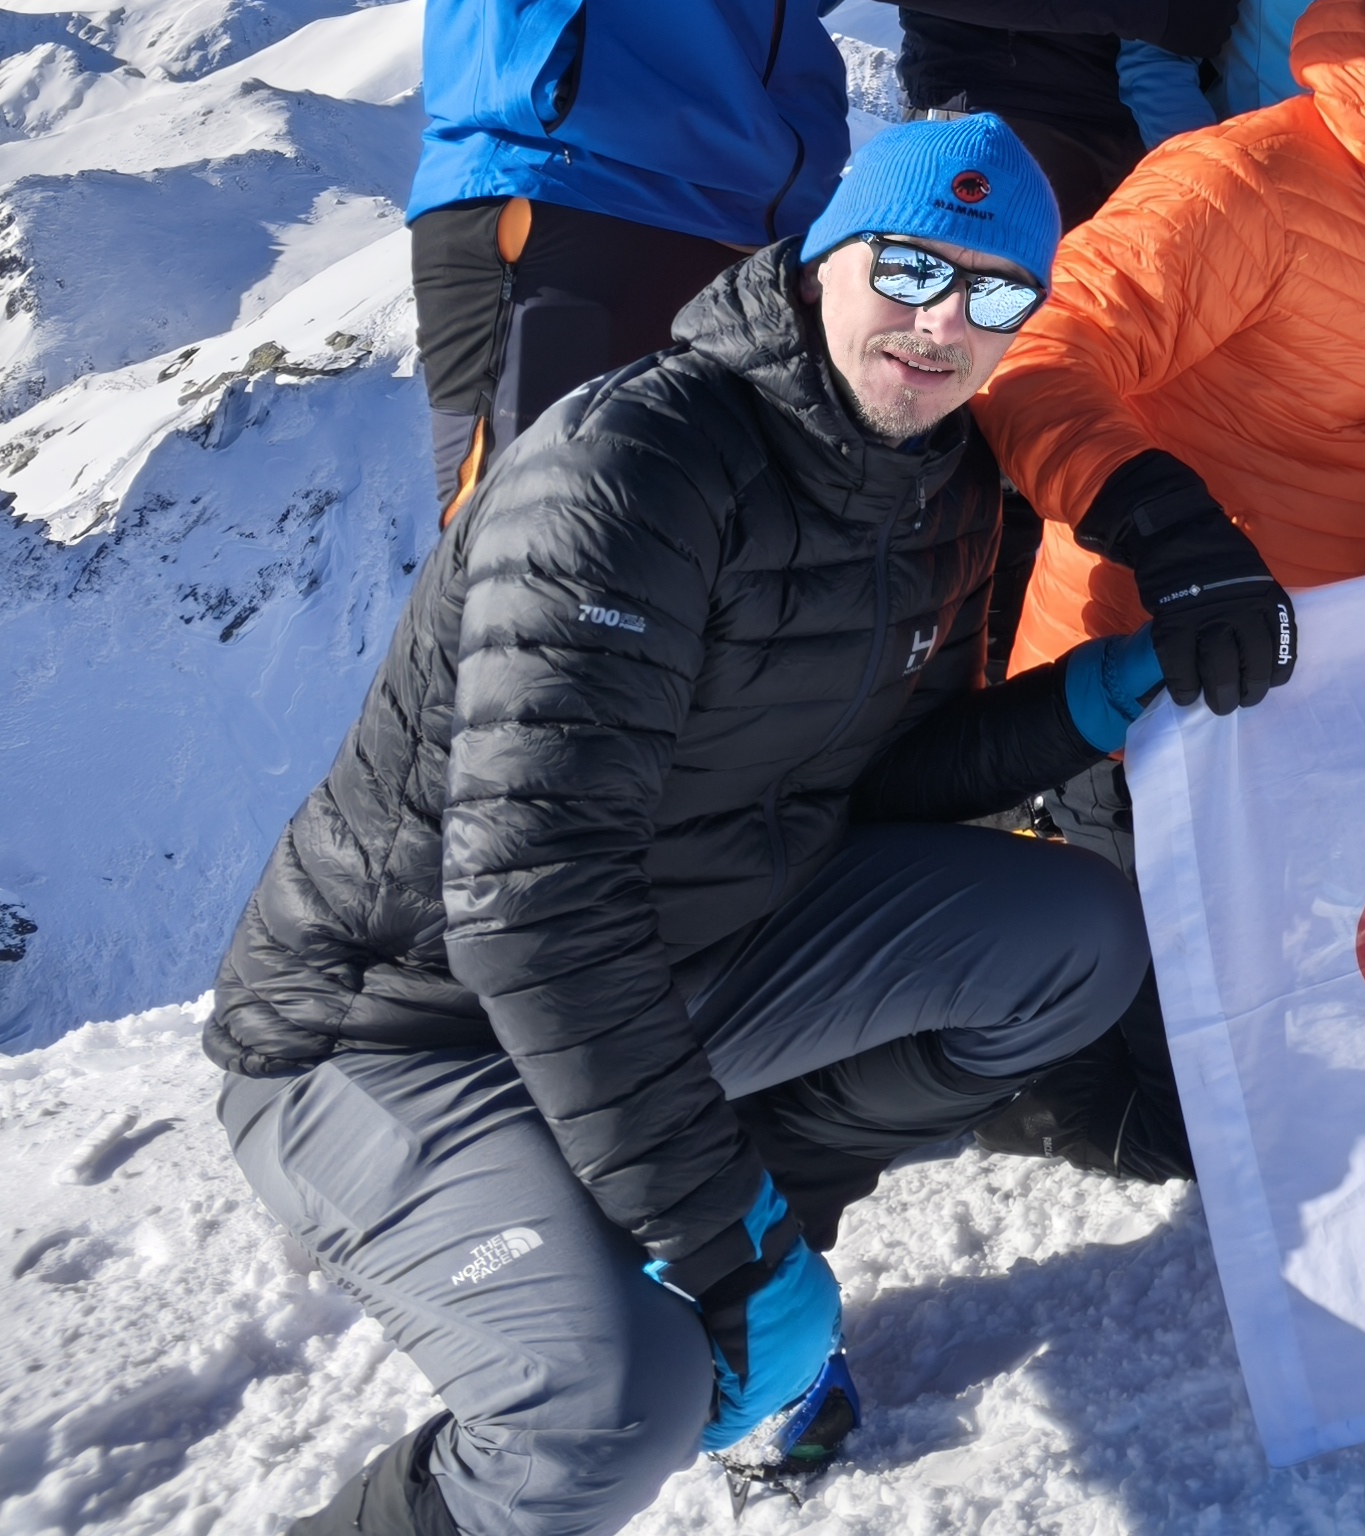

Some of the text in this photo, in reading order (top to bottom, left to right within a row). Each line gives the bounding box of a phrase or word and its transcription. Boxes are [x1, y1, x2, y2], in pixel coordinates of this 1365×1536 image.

[933, 199, 995, 221] MAMMUT
[578, 604, 621, 627] 700
[1277, 603, 1292, 666] reusch
[469, 1233, 502, 1259] THE
[451, 1239, 510, 1286] NORTH
[471, 1251, 513, 1284] FACE
